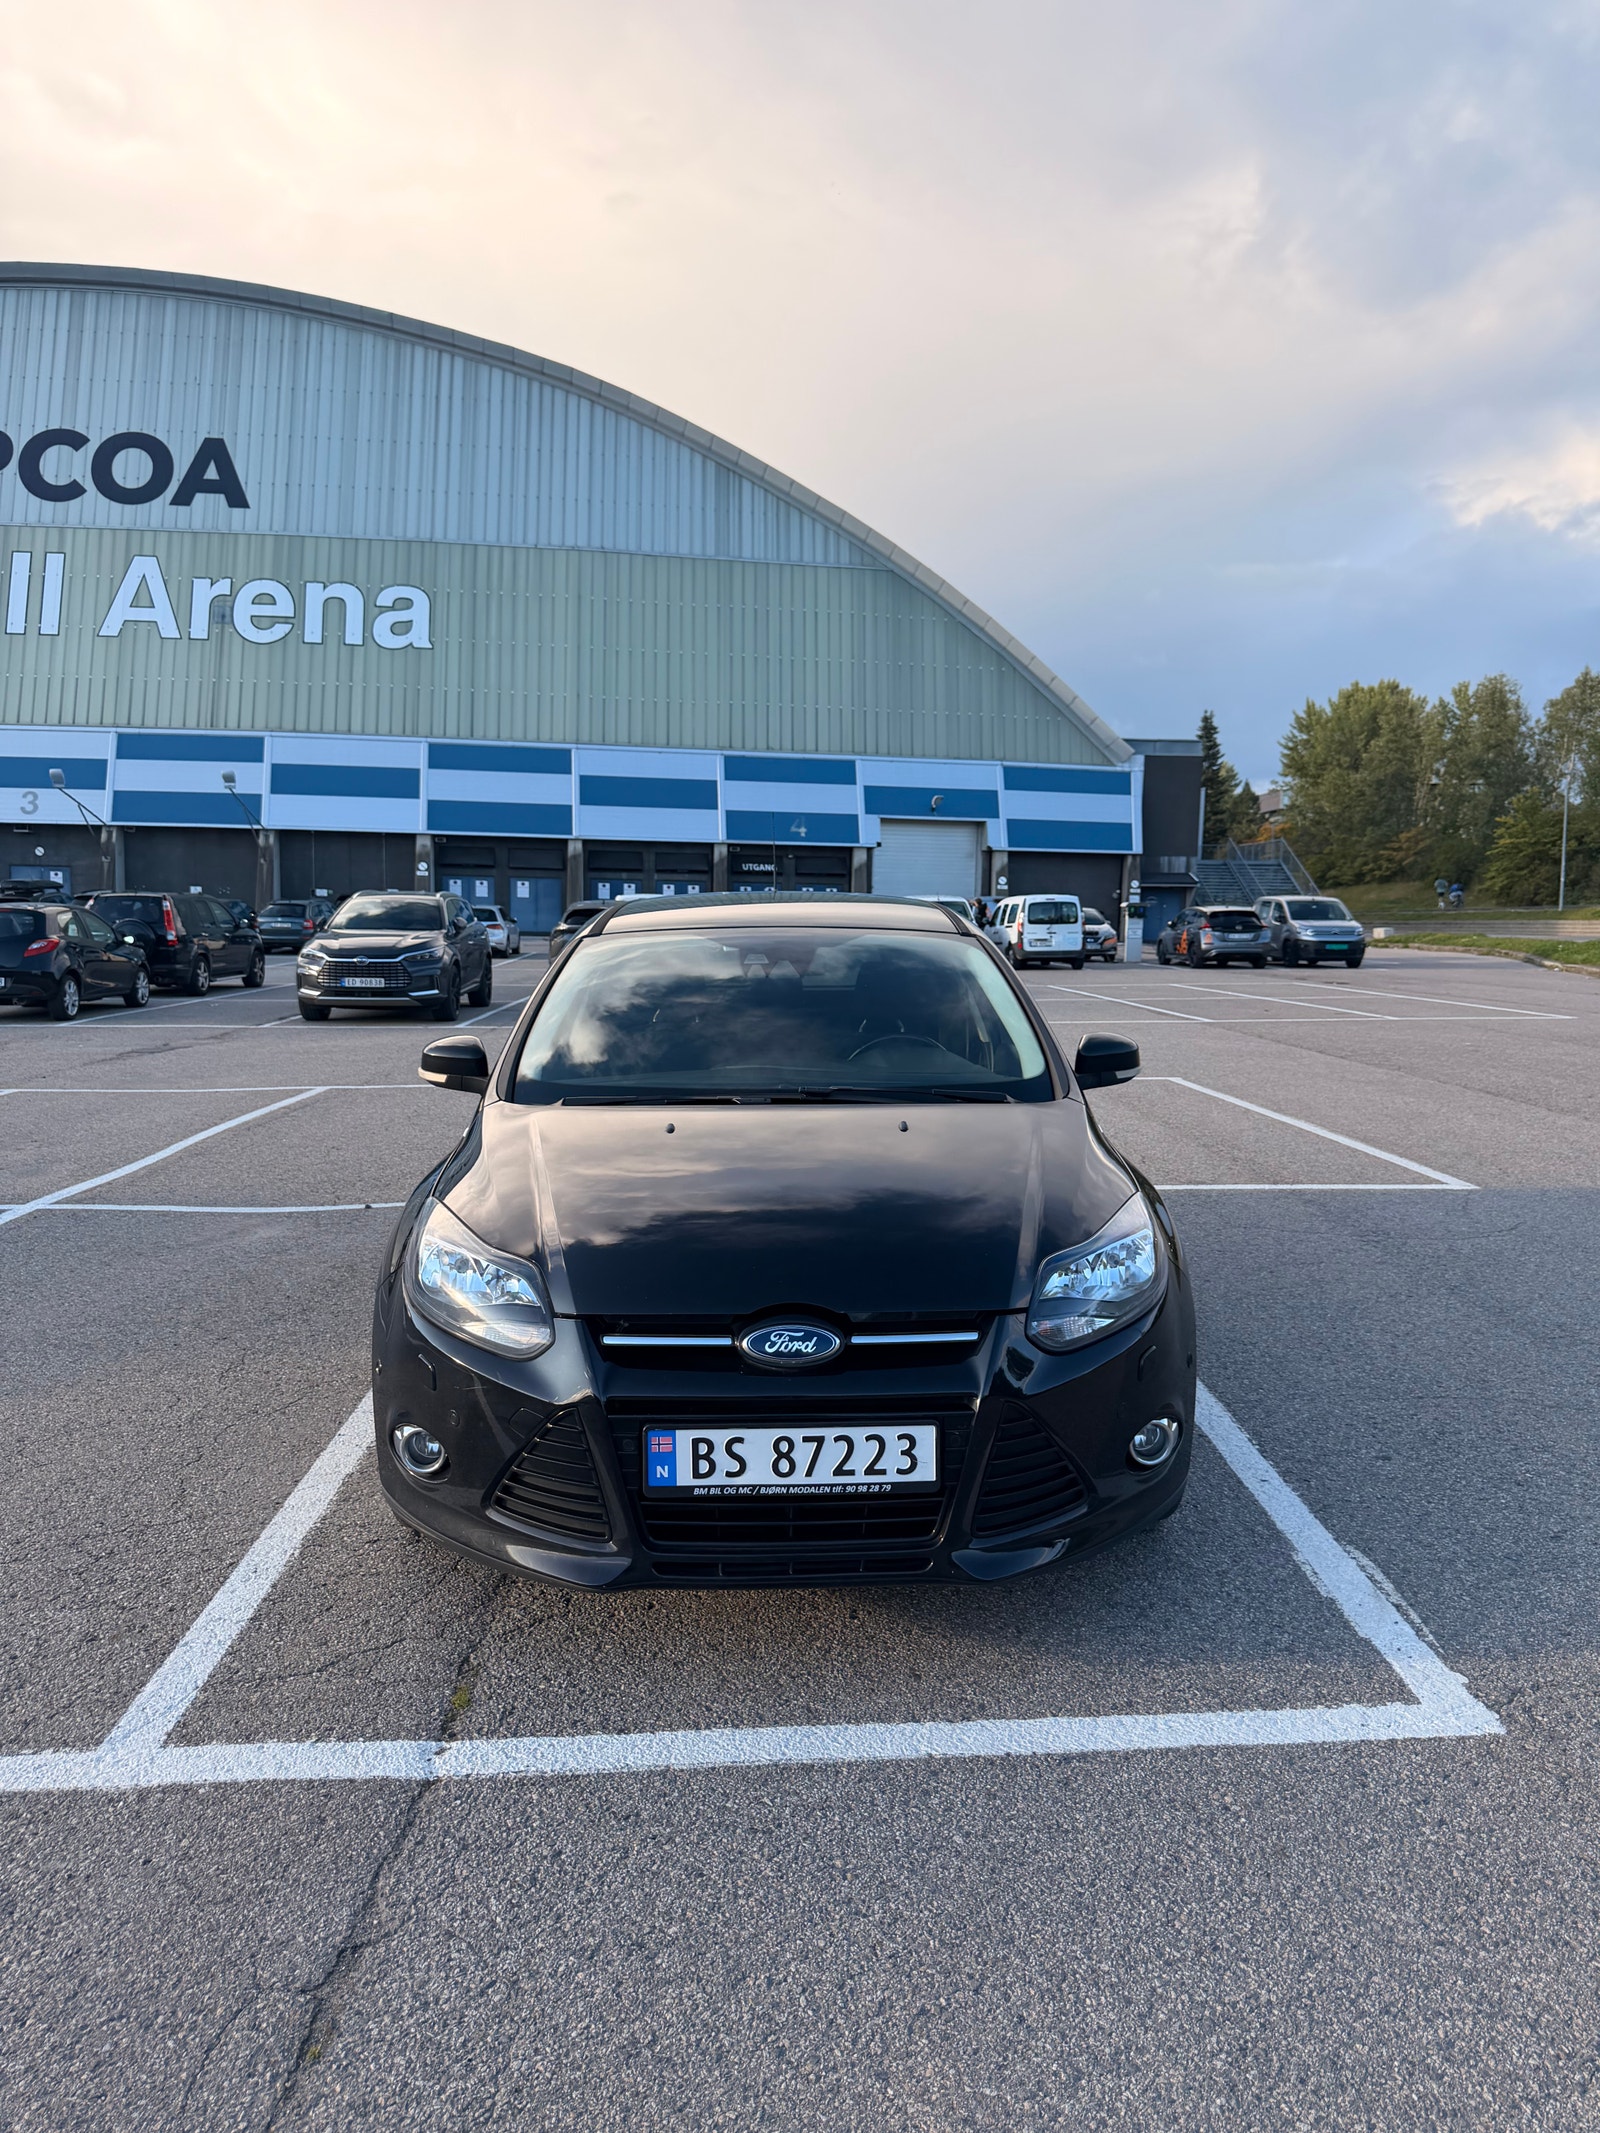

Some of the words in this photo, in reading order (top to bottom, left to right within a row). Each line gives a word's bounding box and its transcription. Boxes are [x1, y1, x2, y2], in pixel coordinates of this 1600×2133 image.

[97, 555, 434, 650] Arena
[20, 790, 39, 815] 3
[790, 815, 807, 837] 4
[764, 1330, 818, 1353] Ford
[656, 1465, 669, 1478] N
[690, 1436, 747, 1479] BS
[770, 1433, 918, 1478] 87223
[693, 1487, 708, 1495] BM
[709, 1487, 722, 1495] BIL
[738, 1486, 753, 1494] MC
[760, 1486, 787, 1494] BJØRN
[788, 1485, 831, 1494] MODALEN
[845, 1485, 857, 1493] 90
[857, 1485, 868, 1493] 98
[868, 1484, 880, 1492] 28
[881, 1484, 892, 1492] 79
